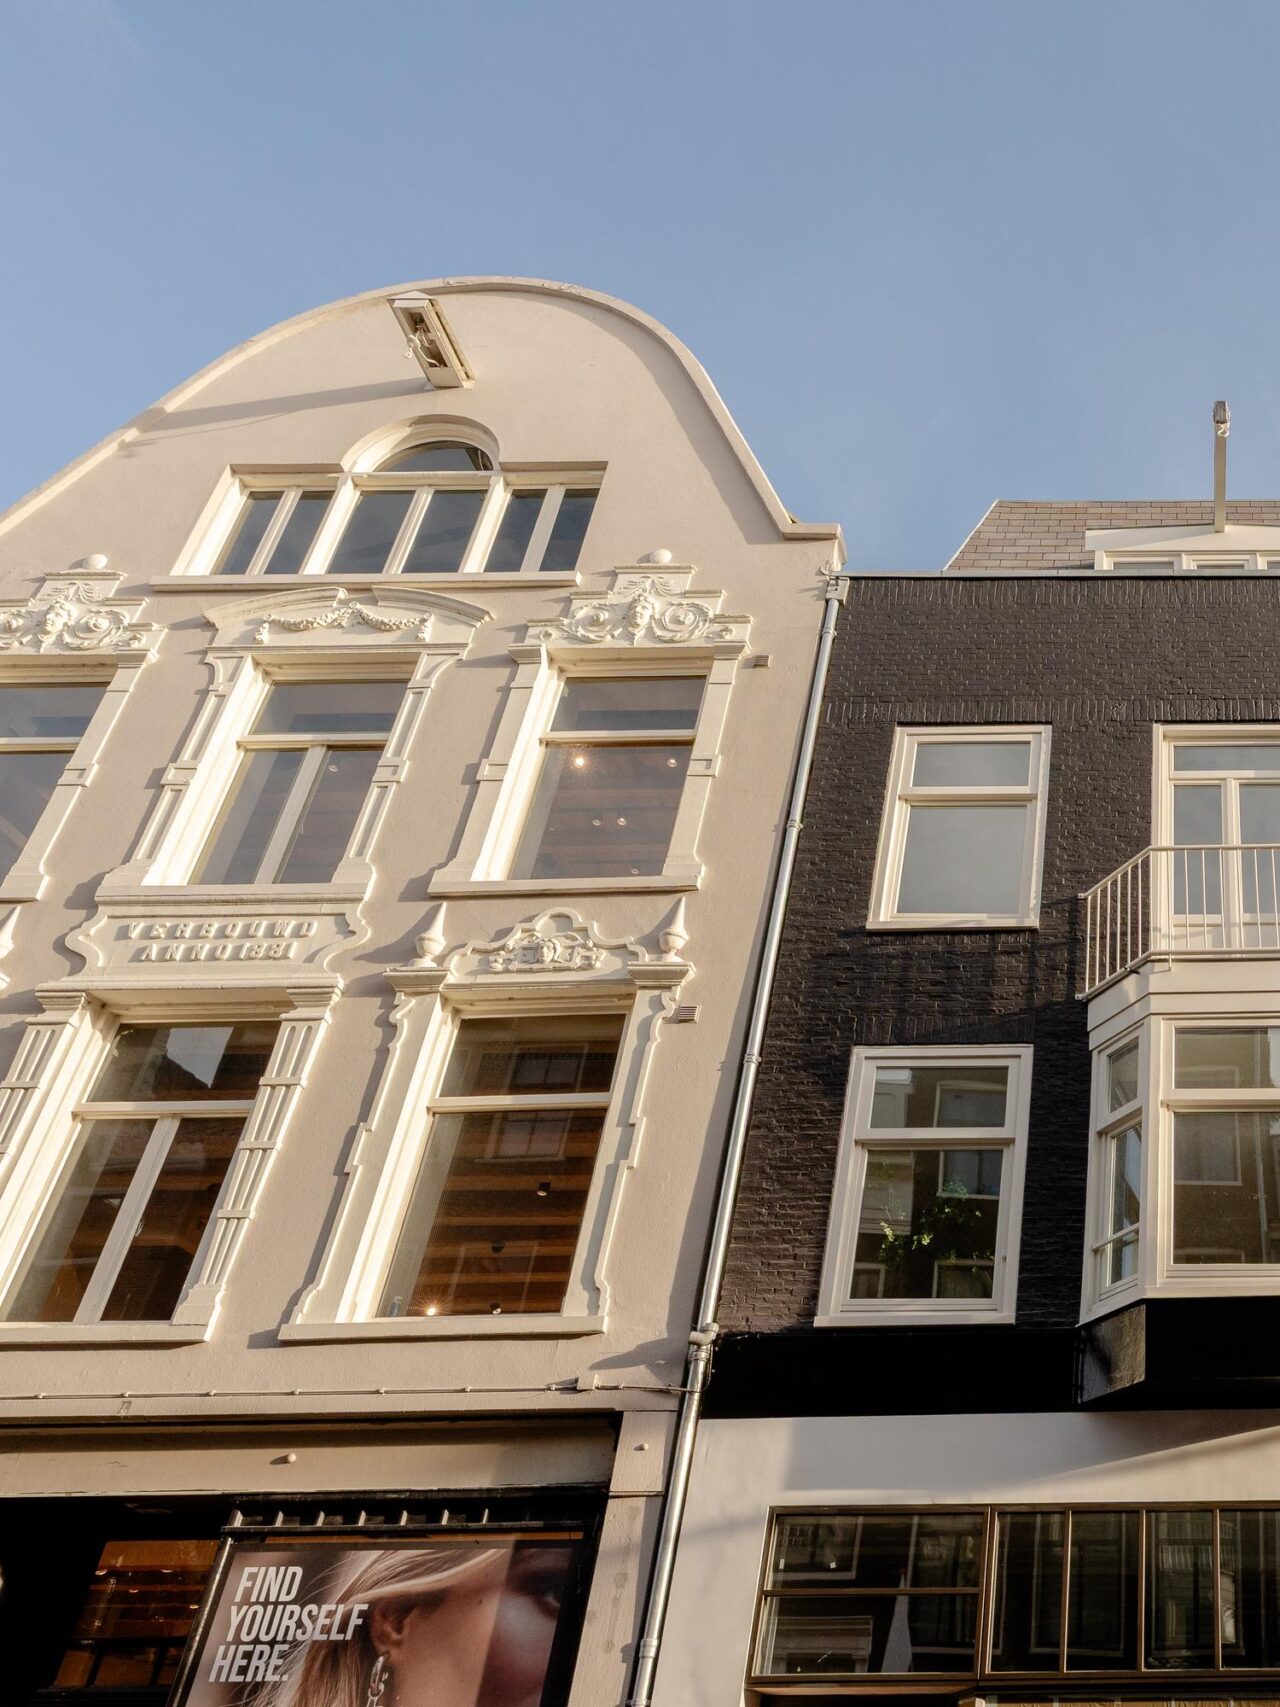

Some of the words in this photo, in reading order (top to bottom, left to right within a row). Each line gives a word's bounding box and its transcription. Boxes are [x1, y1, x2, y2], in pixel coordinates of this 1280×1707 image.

[127, 920, 318, 938] VERBOUWD
[140, 943, 231, 961] ANNO
[240, 941, 297, 960] 1881
[234, 1566, 303, 1602] FIND
[227, 1603, 368, 1641] YOURSELF
[208, 1644, 289, 1682] HERE.
